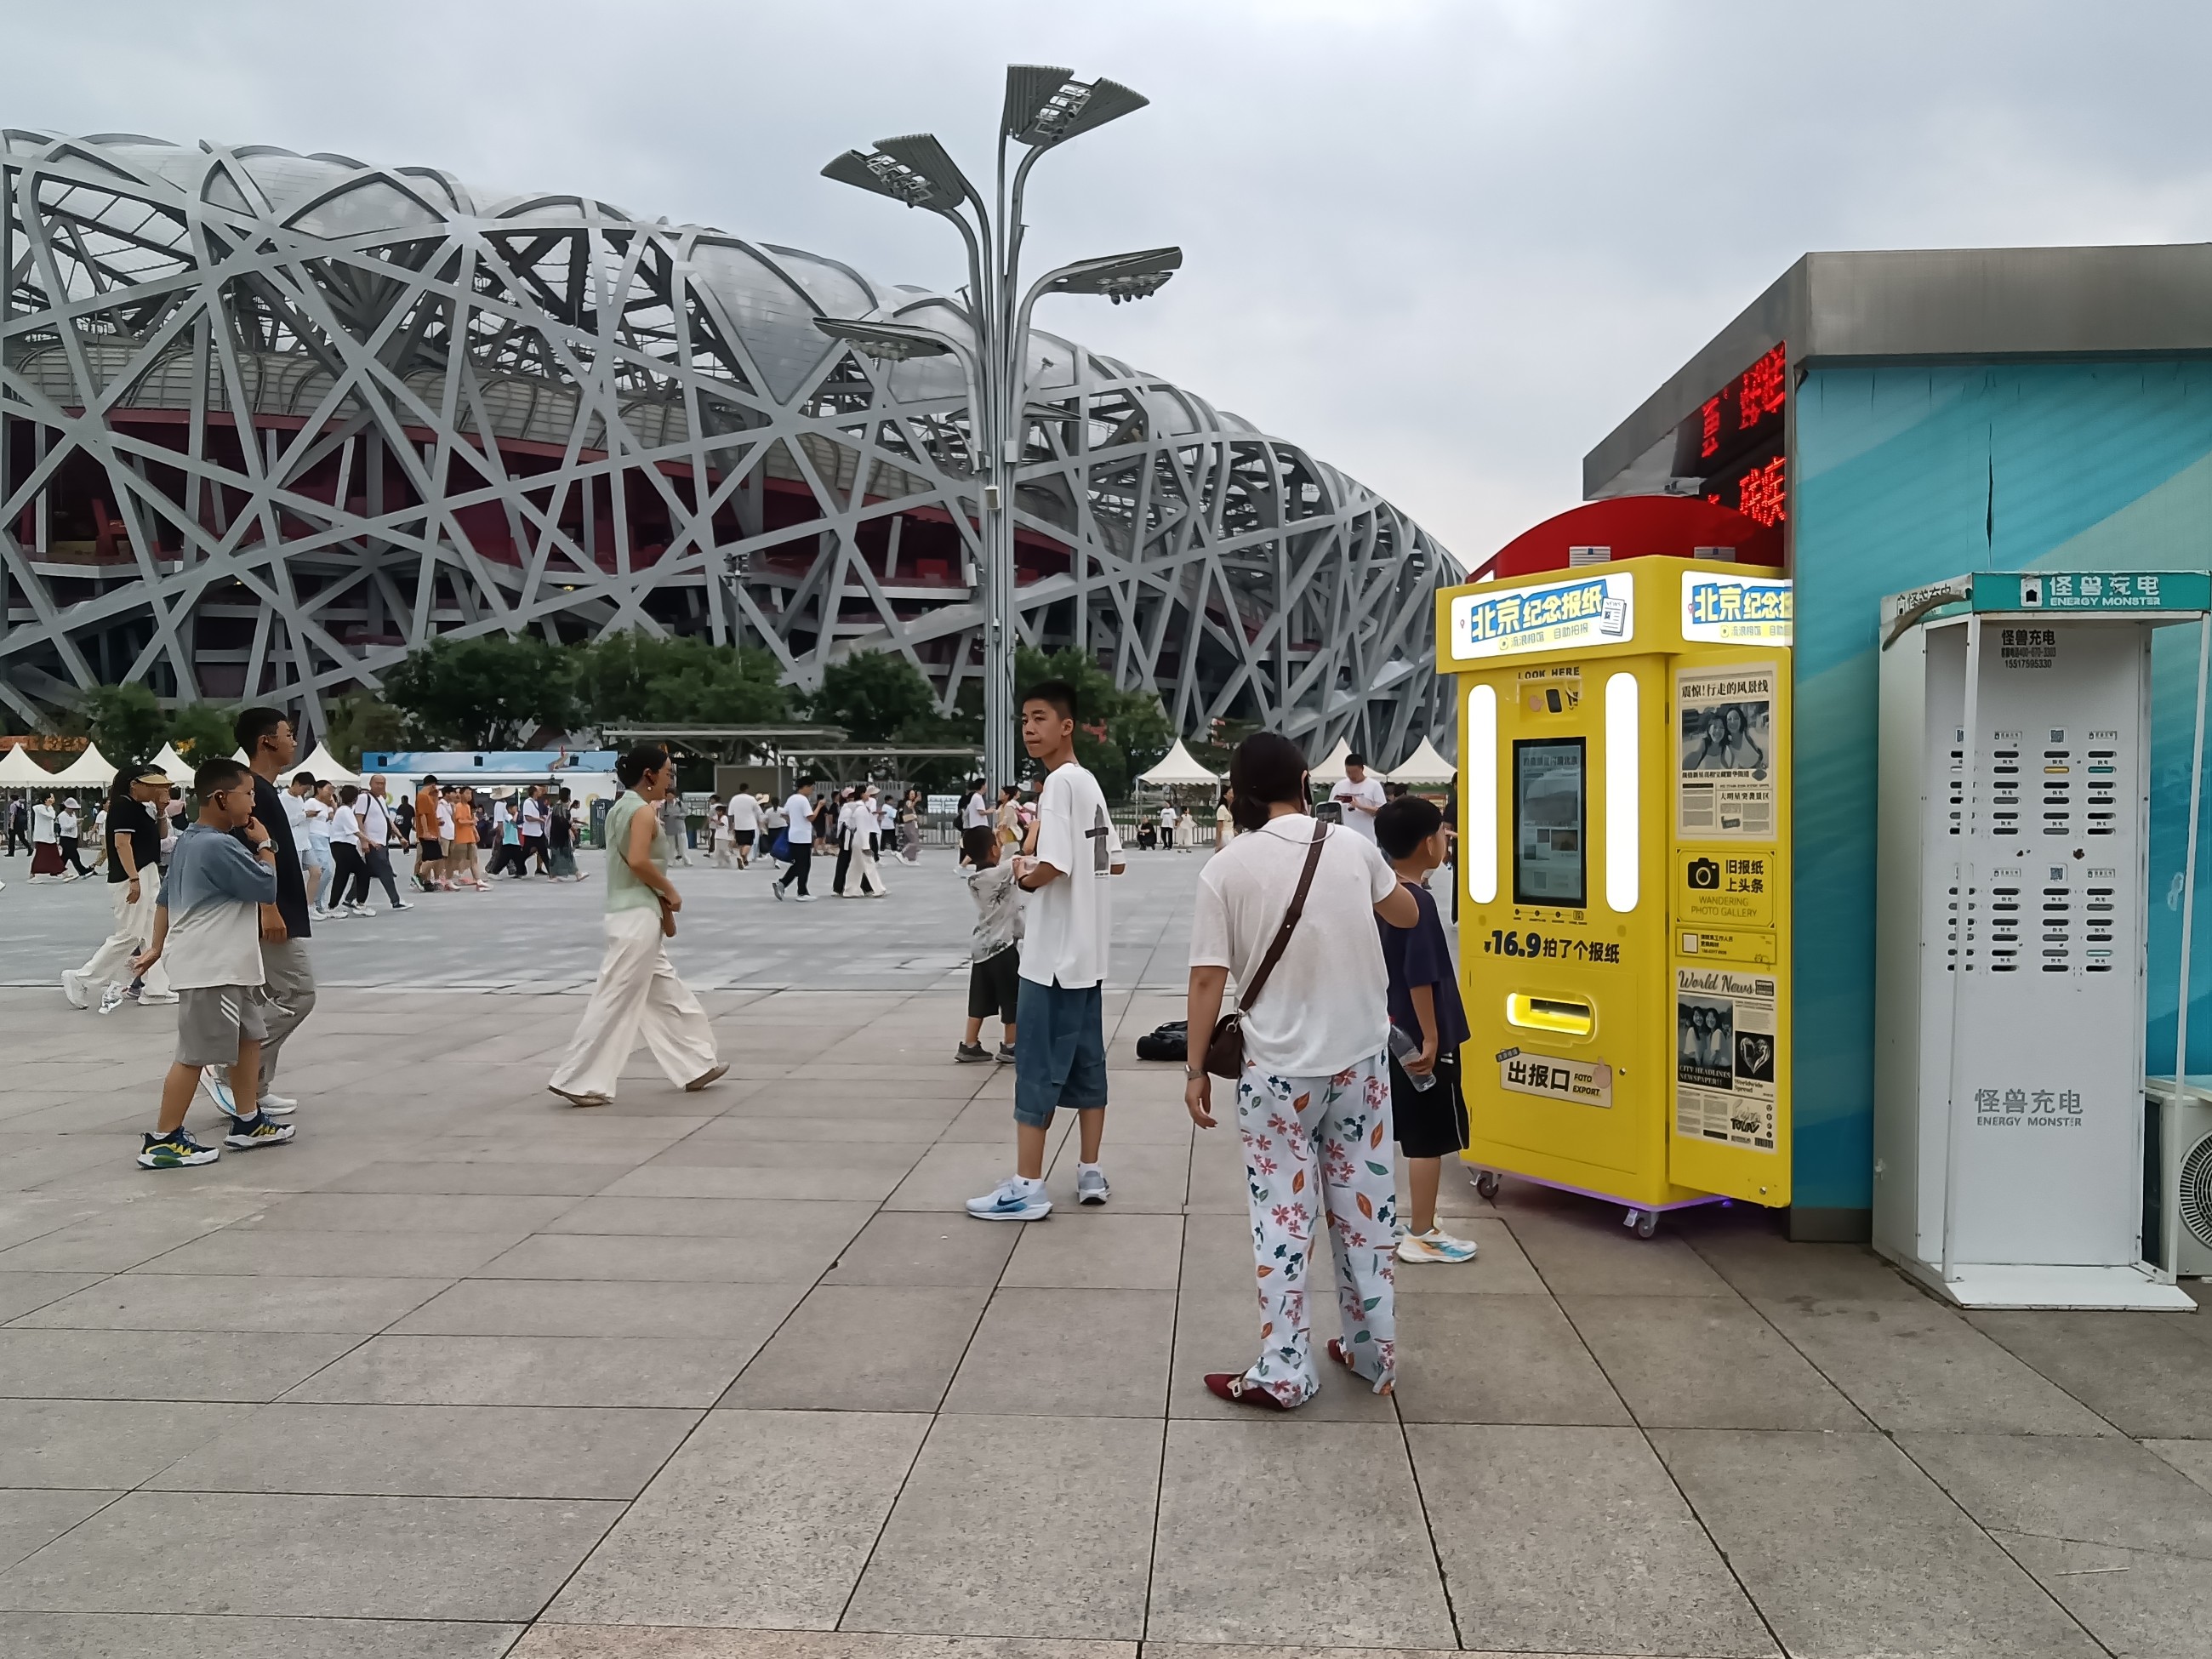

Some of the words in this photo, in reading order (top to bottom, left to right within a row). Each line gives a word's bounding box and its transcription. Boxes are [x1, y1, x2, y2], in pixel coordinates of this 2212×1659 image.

[2050, 576, 2159, 596] 怪兽充电
[2050, 597, 2099, 606] ENERGY
[2102, 597, 2160, 606] MONSTER
[1472, 584, 1603, 641] 北京纪念报纸
[2002, 629, 2055, 645] 怪兽充电
[1551, 666, 1580, 676] HERE
[1725, 859, 1764, 875] 旧报纸
[1725, 877, 1764, 893] 上头条
[1699, 896, 1749, 907] WANDERING
[1690, 905, 1719, 916] PHOTO
[1721, 907, 1758, 917] GALLERY
[1678, 970, 1719, 990] World
[1721, 974, 1754, 995] News
[1508, 1060, 1571, 1092] 出报口
[1573, 1073, 1593, 1083] FOTO
[1695, 1066, 1731, 1079] HEADLINES
[1572, 1085, 1600, 1097] EXPORT
[1975, 1088, 2084, 1115] 怪兽充电
[1976, 1116, 2021, 1126] ENERGY
[2027, 1116, 2082, 1126] MONSTER
